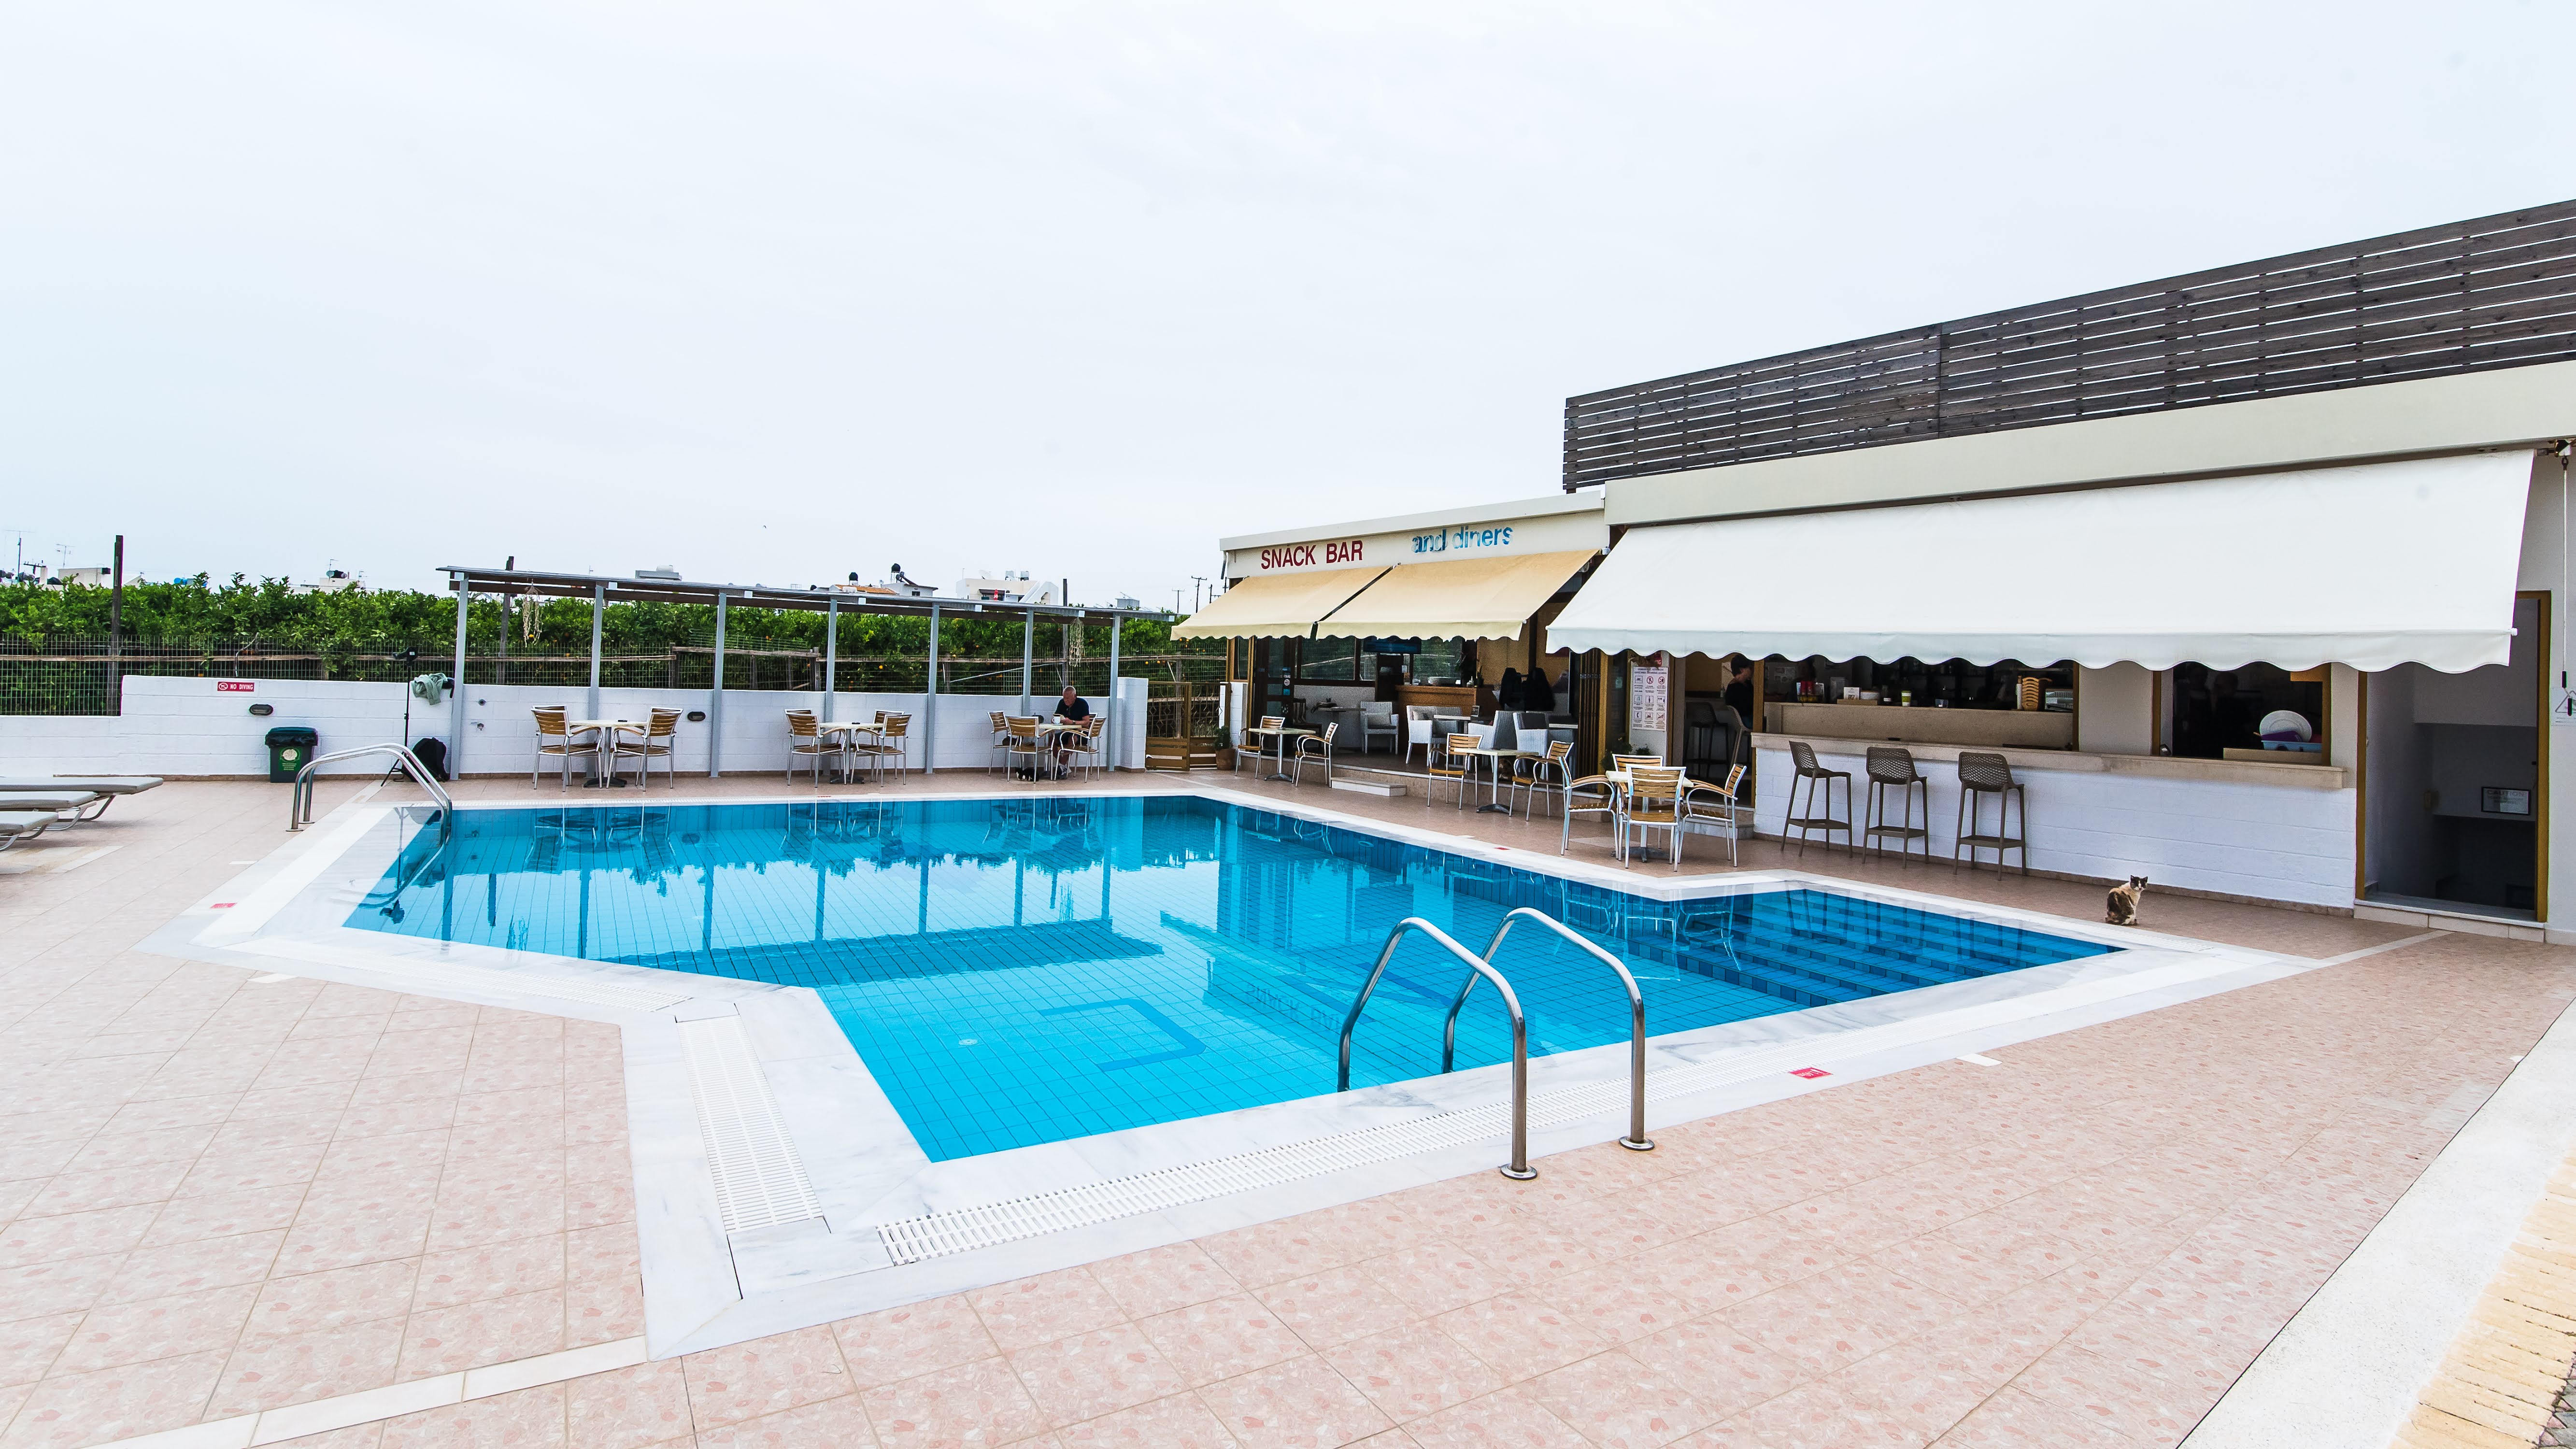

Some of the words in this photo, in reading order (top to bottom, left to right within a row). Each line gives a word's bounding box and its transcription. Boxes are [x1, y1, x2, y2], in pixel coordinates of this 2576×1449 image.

[1411, 528, 1448, 554] and
[1452, 526, 1513, 549] diners
[1261, 544, 1317, 569] SNACK
[1326, 540, 1363, 564] BAR
